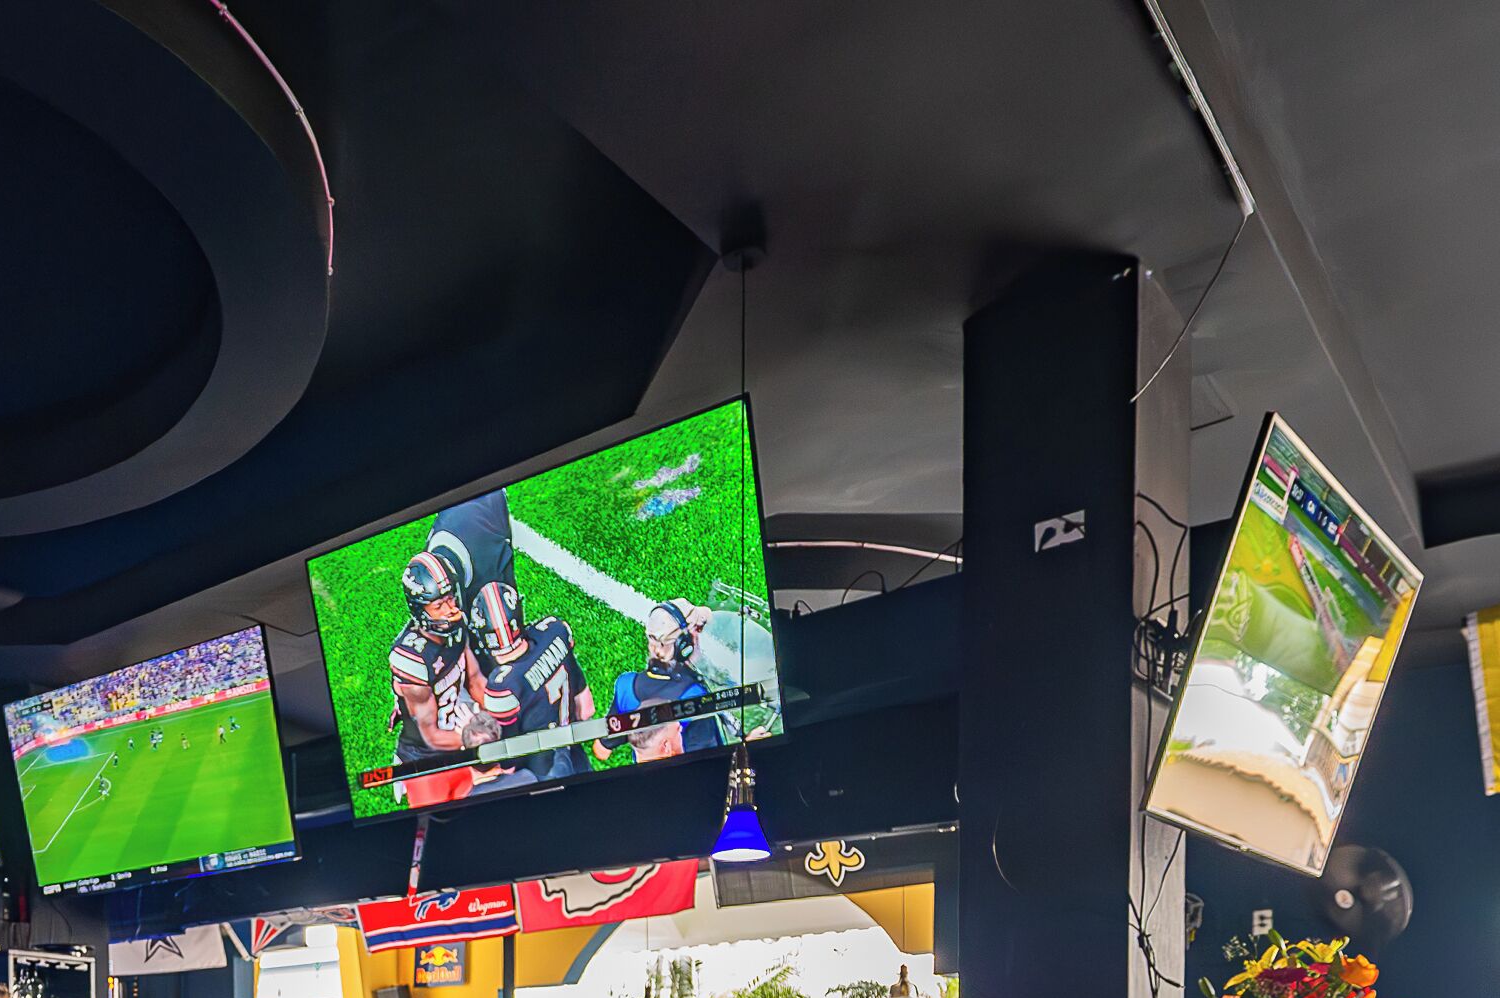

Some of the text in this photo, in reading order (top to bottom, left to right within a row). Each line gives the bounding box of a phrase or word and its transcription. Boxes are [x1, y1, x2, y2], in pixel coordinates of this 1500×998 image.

[524, 636, 568, 691] BOWMAN
[545, 665, 570, 726] 7
[629, 713, 641, 728] 7
